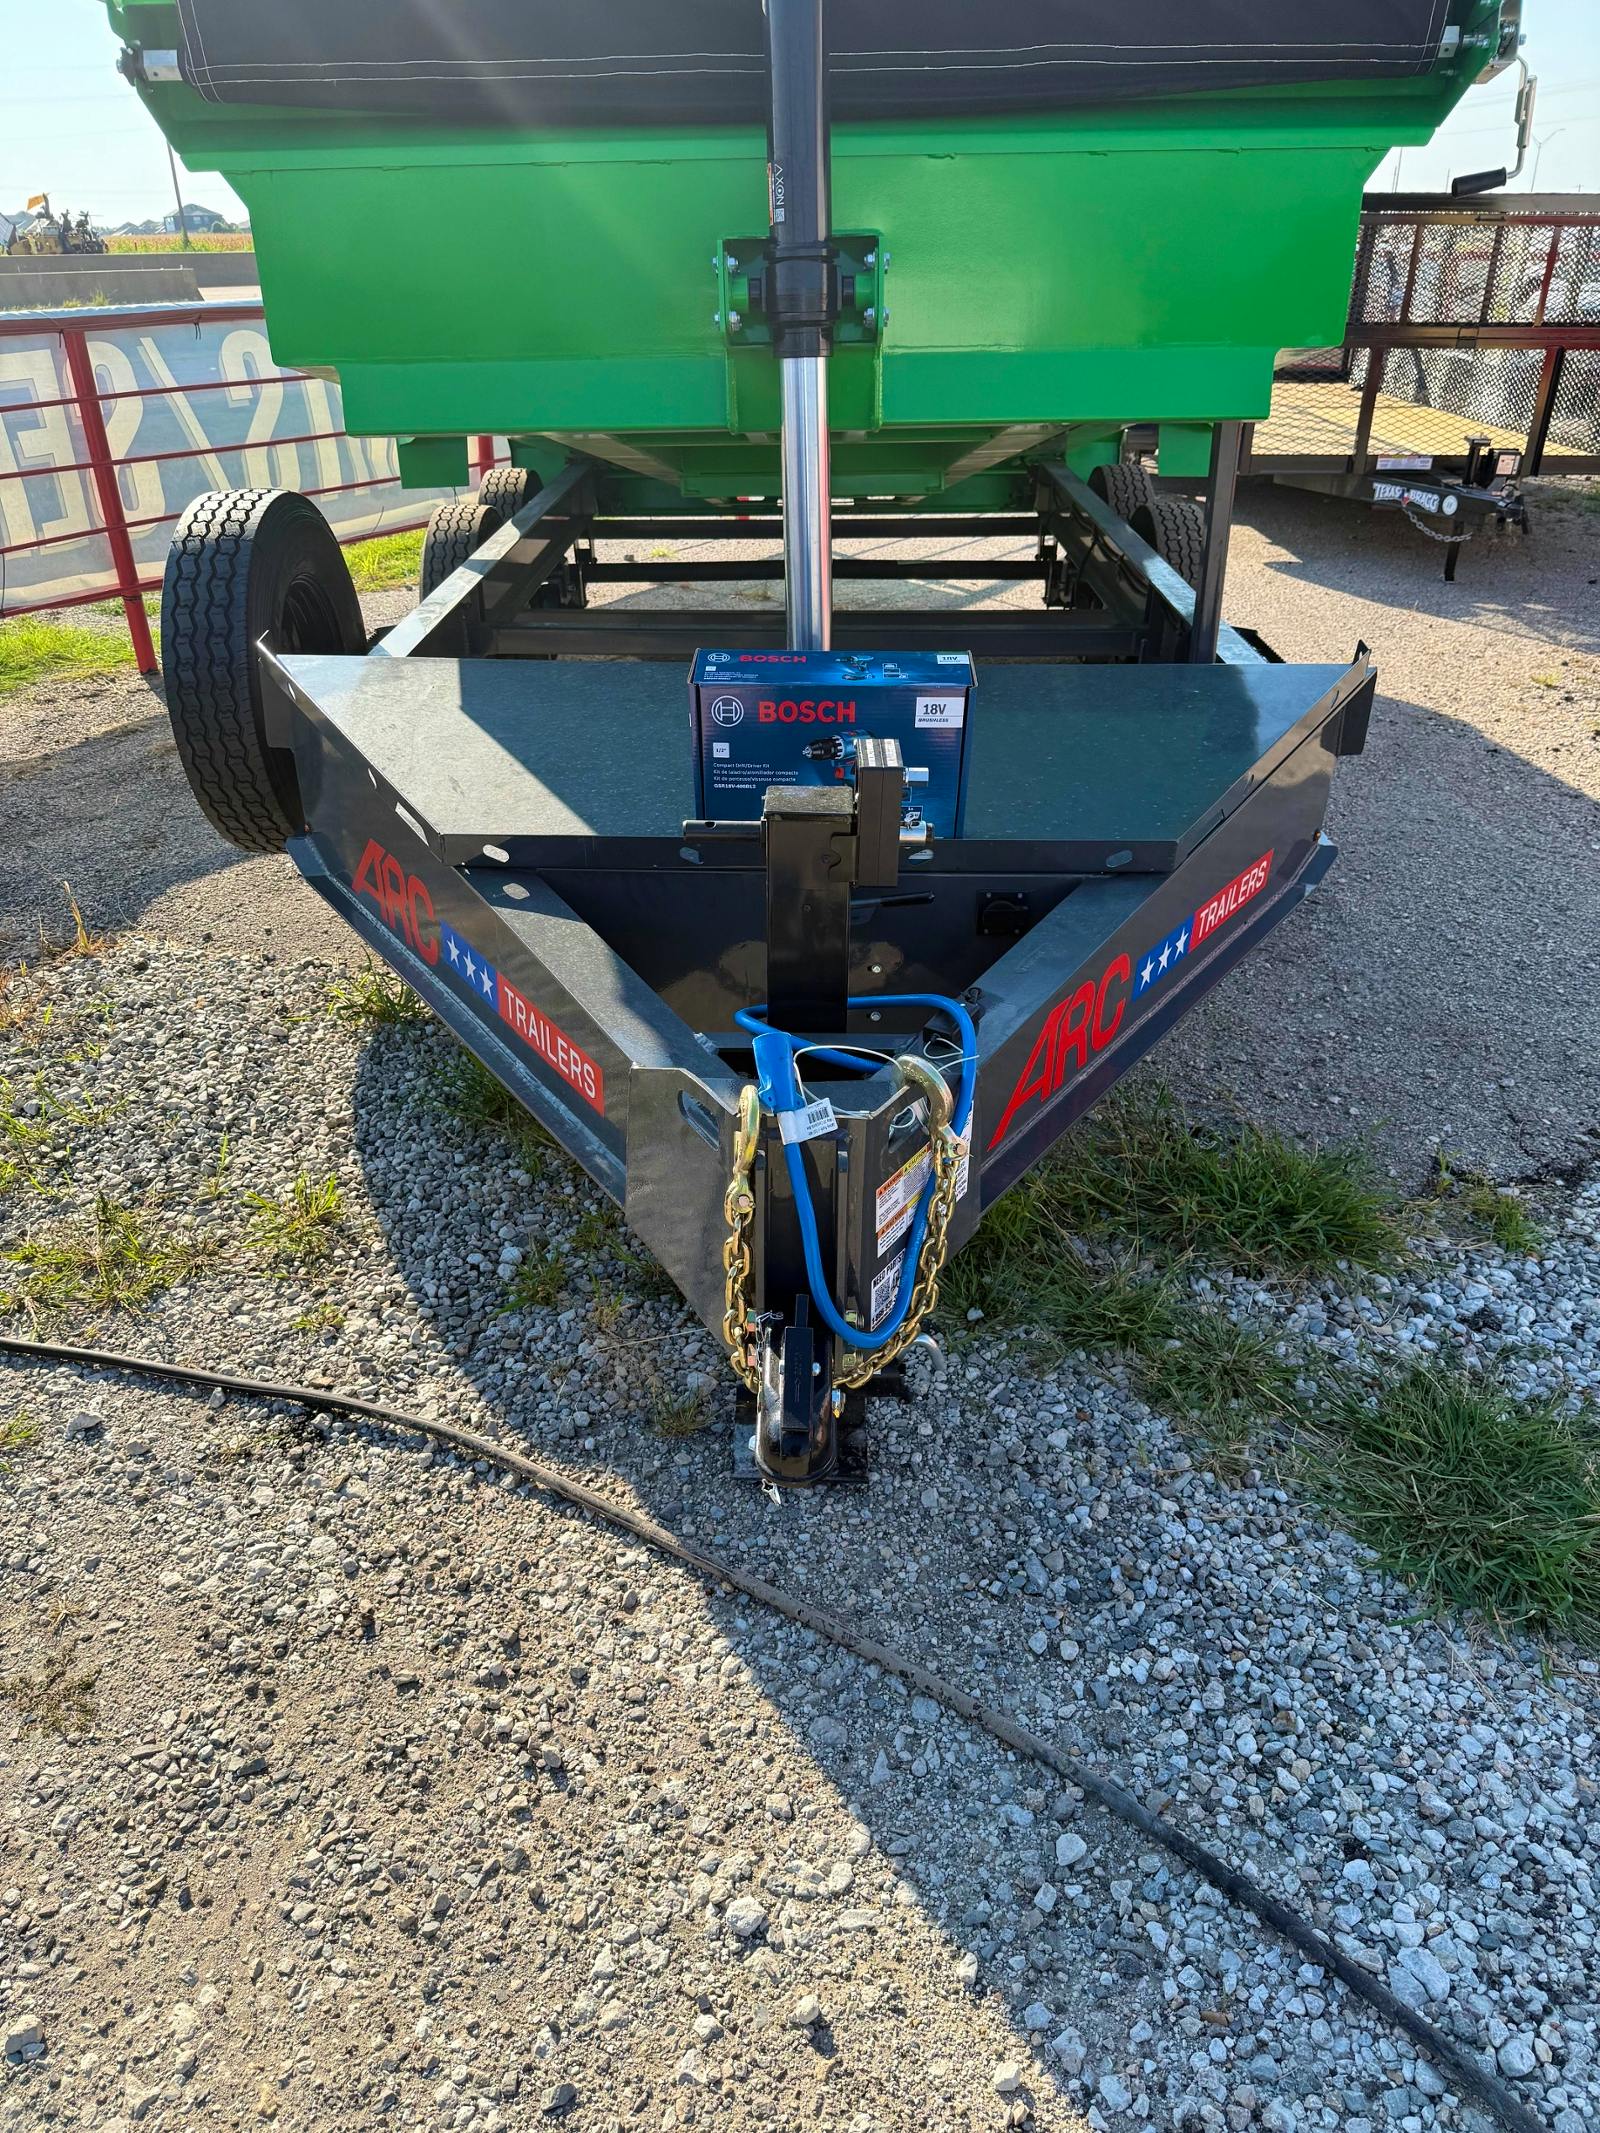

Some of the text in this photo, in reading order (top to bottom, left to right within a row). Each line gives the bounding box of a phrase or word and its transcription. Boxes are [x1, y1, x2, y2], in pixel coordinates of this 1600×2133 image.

[775, 163, 784, 205] AXON
[1373, 483, 1402, 501] TEXAS
[1409, 488, 1440, 513] BRAGG
[739, 655, 807, 663] BOSCH
[758, 700, 856, 723] BOSCH
[922, 703, 947, 715] 18V
[352, 838, 596, 1099] ARC TRAILERS
[986, 860, 1268, 1152] ARC TRAILERS
[873, 1269, 886, 1289] NEED
